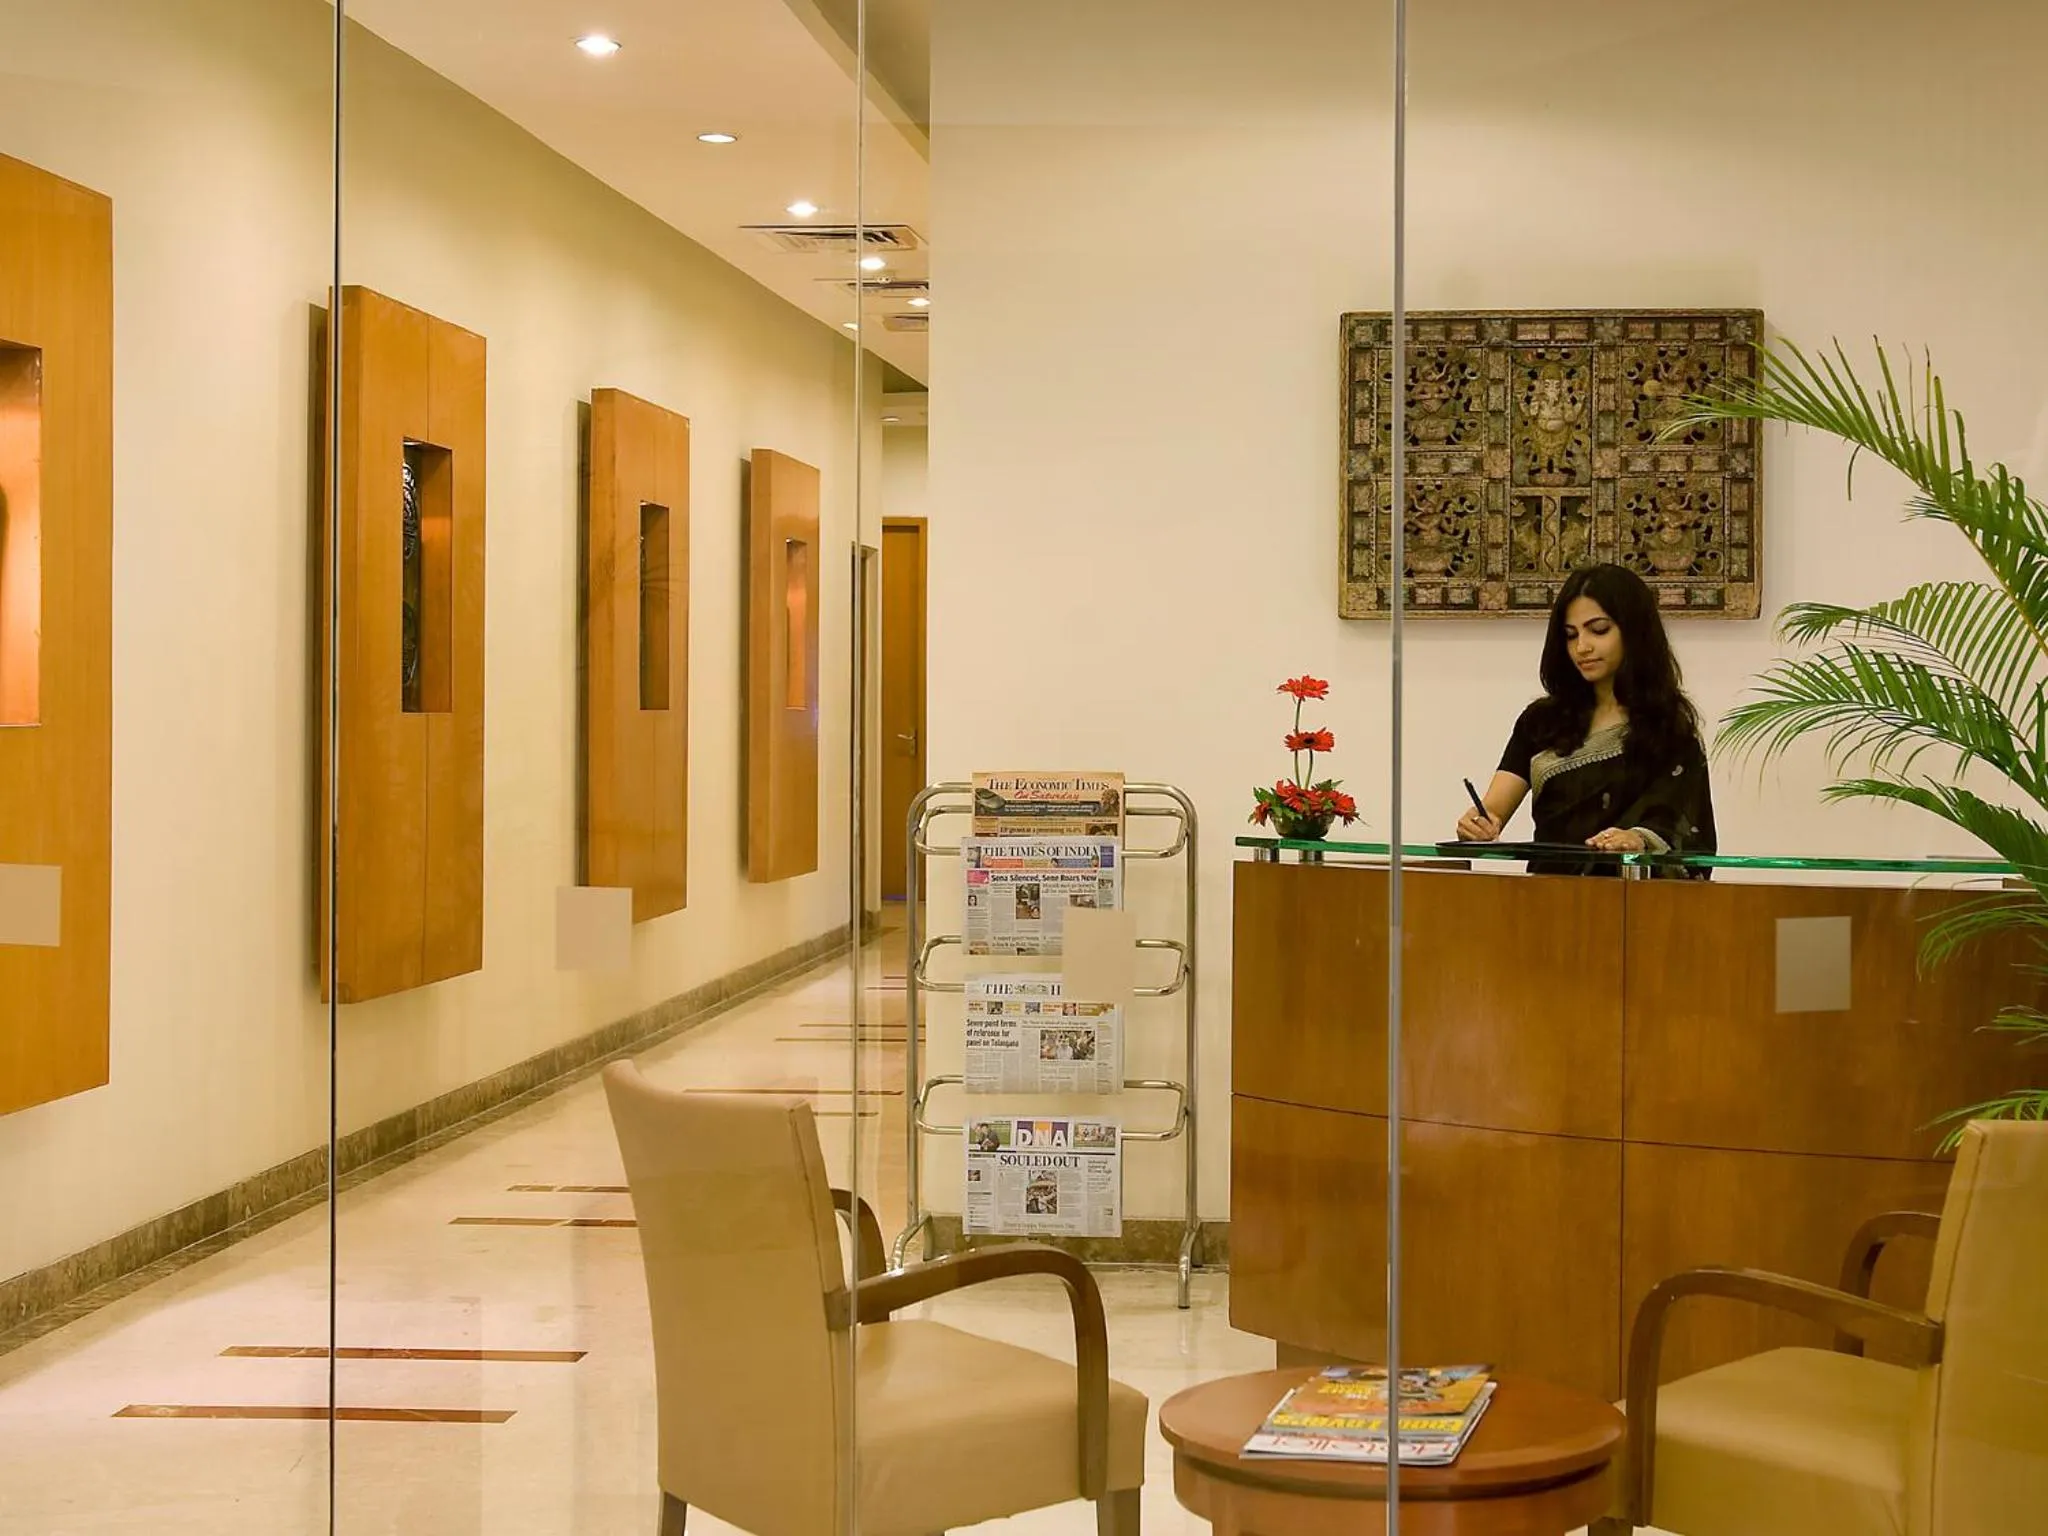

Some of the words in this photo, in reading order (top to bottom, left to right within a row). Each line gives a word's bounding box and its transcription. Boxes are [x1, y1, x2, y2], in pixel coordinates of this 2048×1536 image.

[988, 779, 1011, 790] THE
[1016, 779, 1071, 790] ECONOMIC
[1074, 779, 1109, 790] TIMES
[984, 846, 1007, 856] THE
[1008, 846, 1044, 857] TIMES
[1047, 846, 1062, 857] OF
[1065, 846, 1099, 857] INDIA
[983, 983, 1013, 995] THE
[1017, 1128, 1068, 1147] DNA
[1000, 1155, 1050, 1168] SOULED
[1053, 1155, 1081, 1168] OUT
